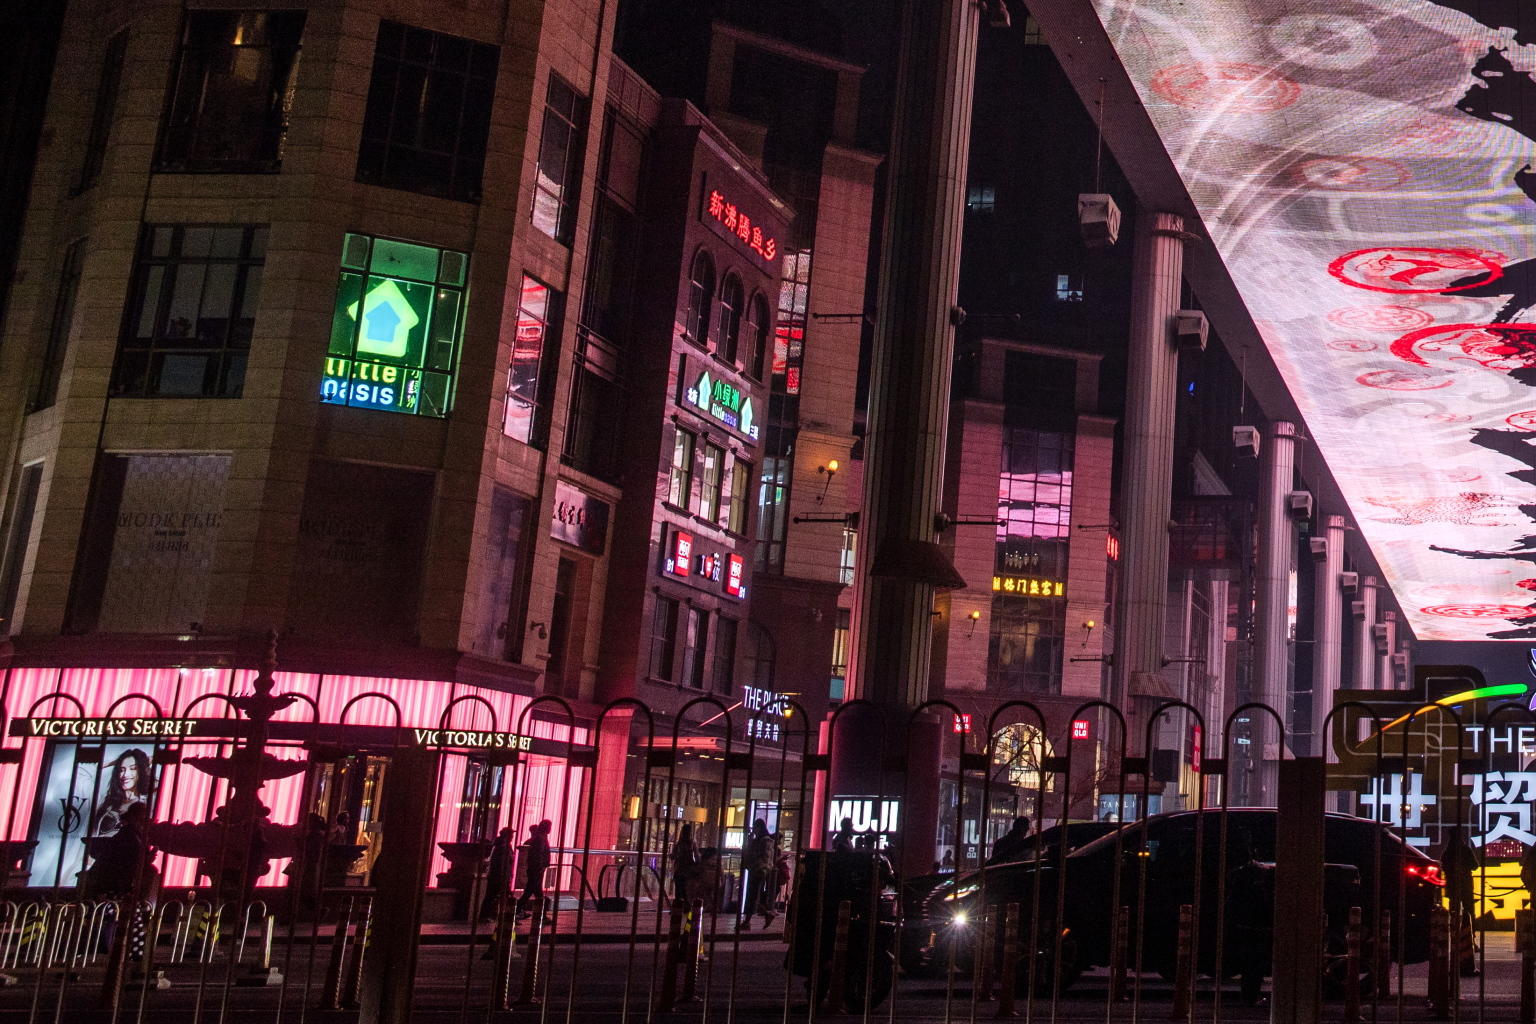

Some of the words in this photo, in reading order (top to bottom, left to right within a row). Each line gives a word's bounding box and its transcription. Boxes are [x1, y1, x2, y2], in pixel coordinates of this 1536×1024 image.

[323, 378, 395, 406] oasis
[743, 685, 762, 711] THE
[31, 718, 127, 735] VICTORIA'S
[132, 719, 197, 735] SECRET
[1074, 721, 1087, 729] UNI
[1074, 729, 1087, 737] QLO
[414, 729, 505, 747] VICTORIA'S
[1465, 727, 1535, 753] THE
[828, 800, 899, 832] MUJI
